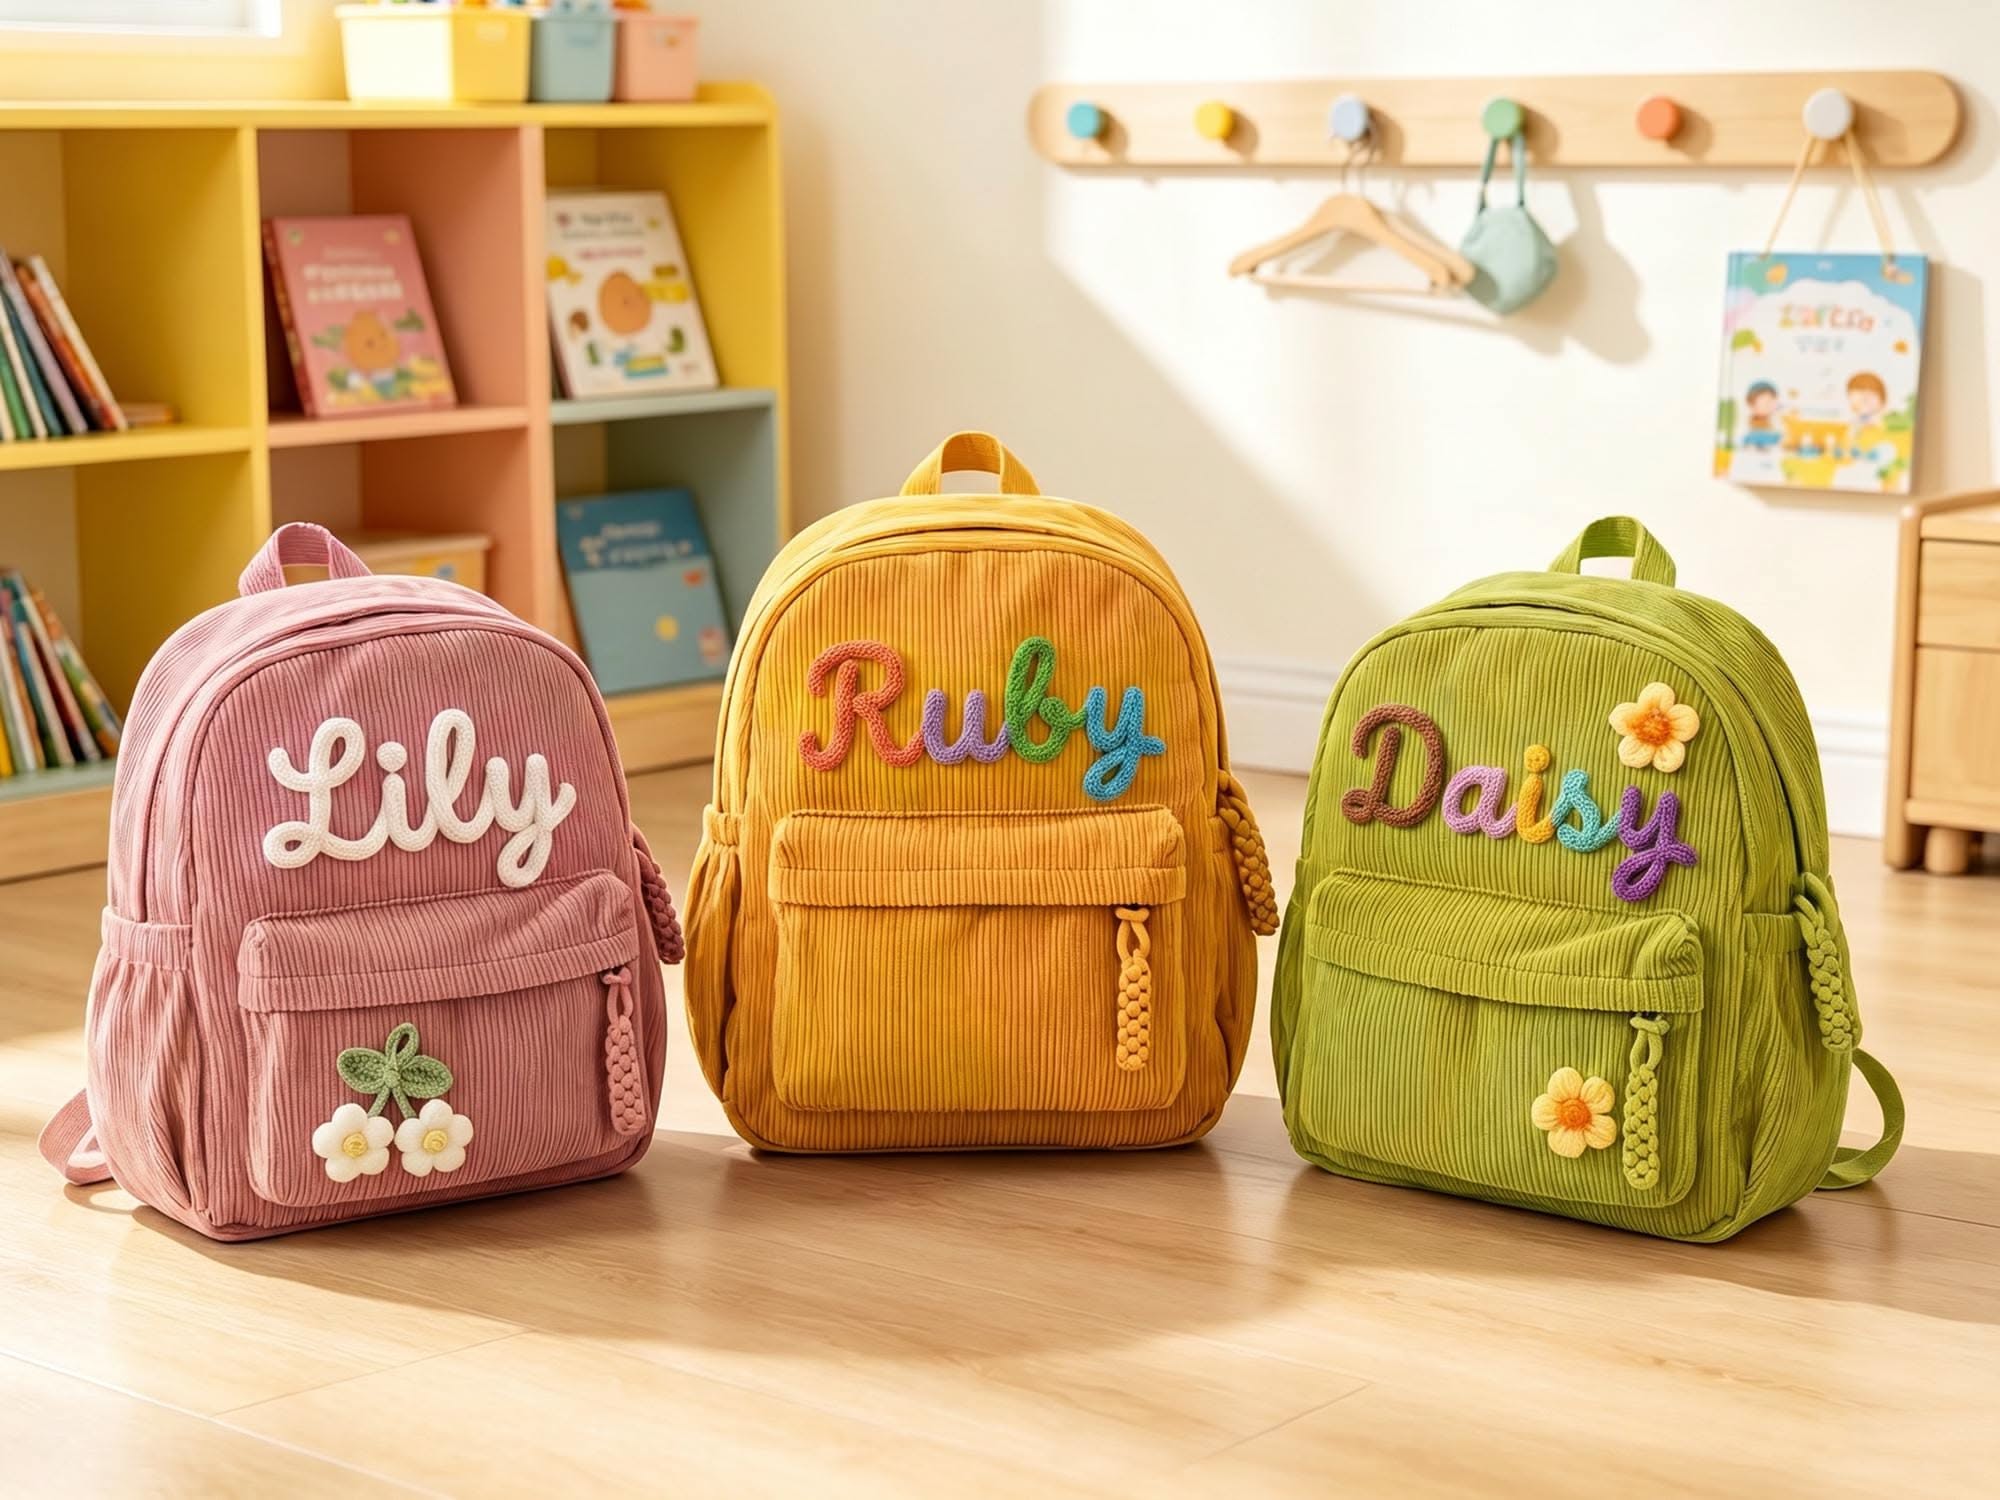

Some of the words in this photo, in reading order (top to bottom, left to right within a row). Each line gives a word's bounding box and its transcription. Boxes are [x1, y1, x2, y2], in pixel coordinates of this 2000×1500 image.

[263, 708, 577, 888] Lily
[800, 636, 1166, 801] Ruby
[1342, 703, 1697, 902] Daisy
